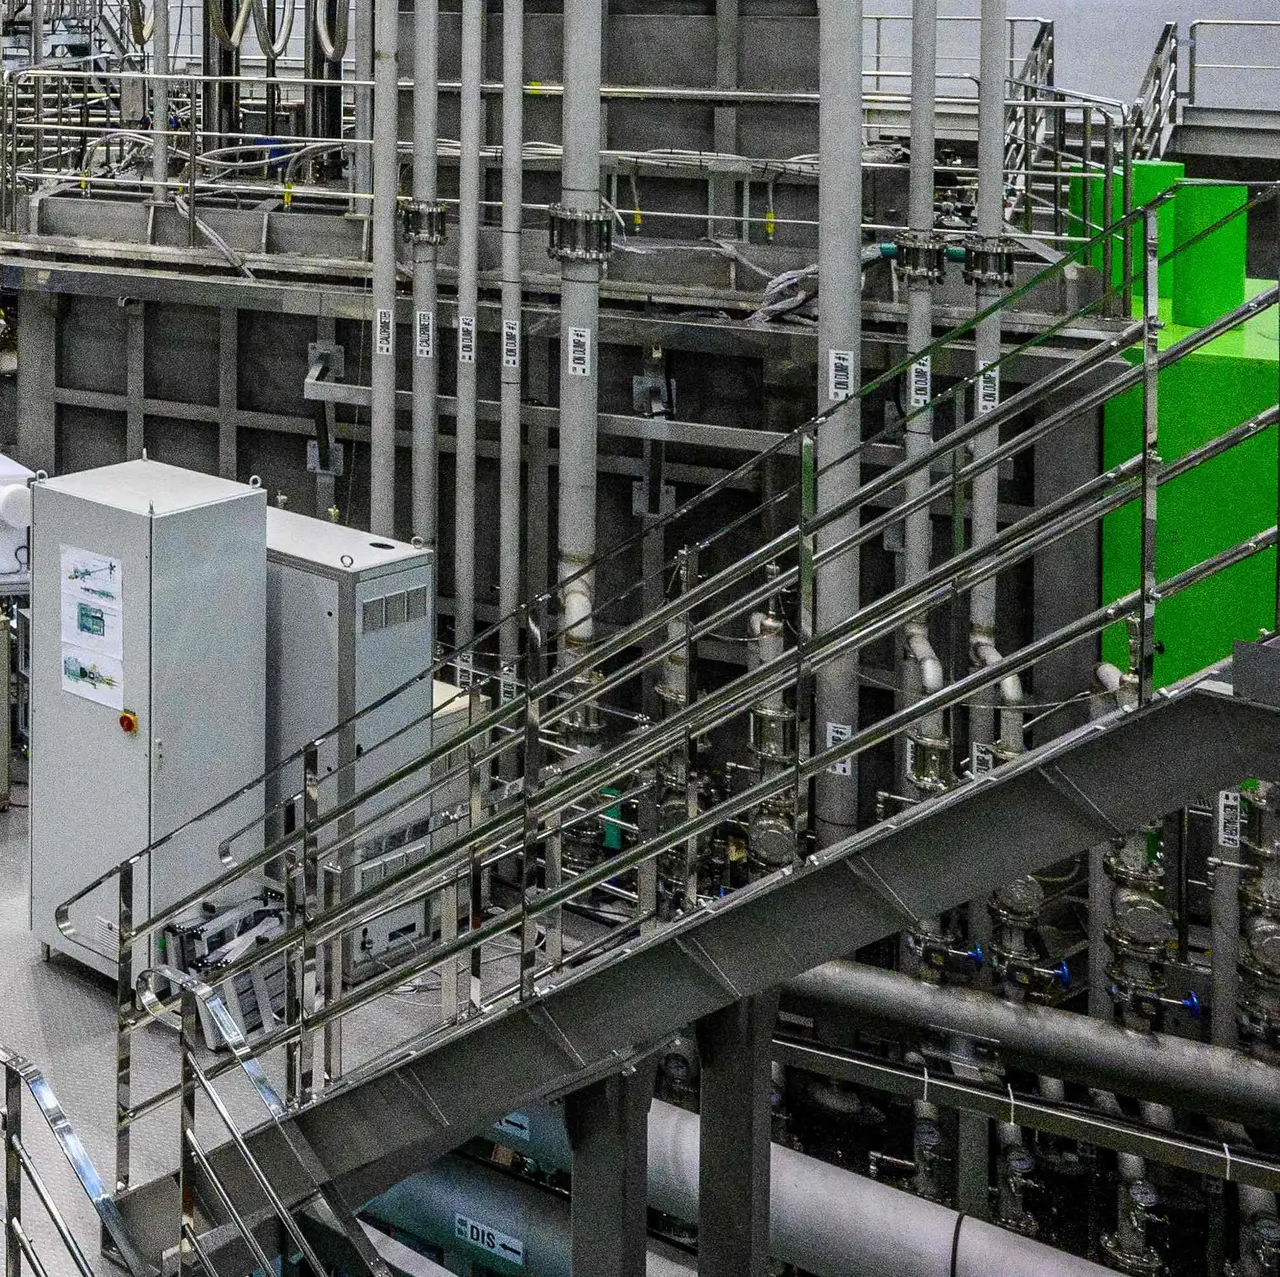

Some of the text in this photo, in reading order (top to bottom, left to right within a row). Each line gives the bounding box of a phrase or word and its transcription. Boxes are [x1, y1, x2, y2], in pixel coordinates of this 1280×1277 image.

[572, 329, 586, 366] ION DUMP #1
[834, 353, 849, 390] ION DUMP #1
[470, 1224, 496, 1250] DIS
